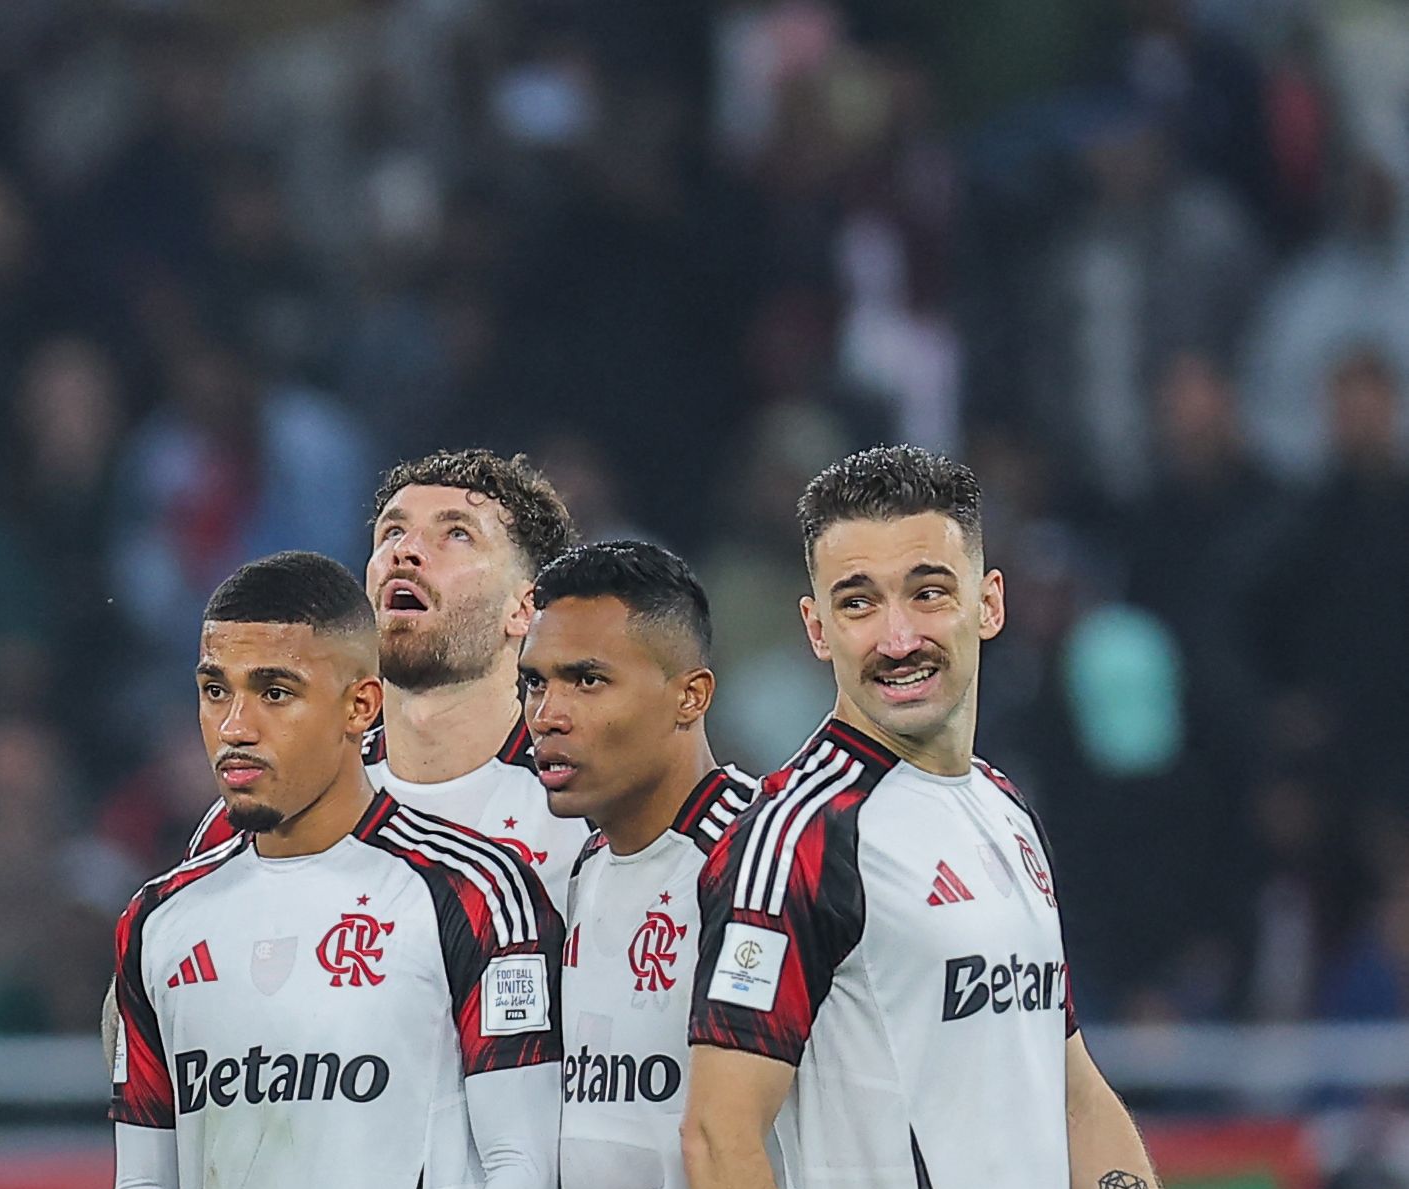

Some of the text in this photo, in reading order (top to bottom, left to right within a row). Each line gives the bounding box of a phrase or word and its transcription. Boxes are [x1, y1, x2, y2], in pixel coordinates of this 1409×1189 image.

[496, 968, 533, 980] FOOTBALL
[497, 980, 534, 995] UNITES
[495, 994, 536, 1007] the World
[507, 1010, 525, 1019] FIFA
[175, 1045, 390, 1115] Betano
[564, 1045, 681, 1103] etano
